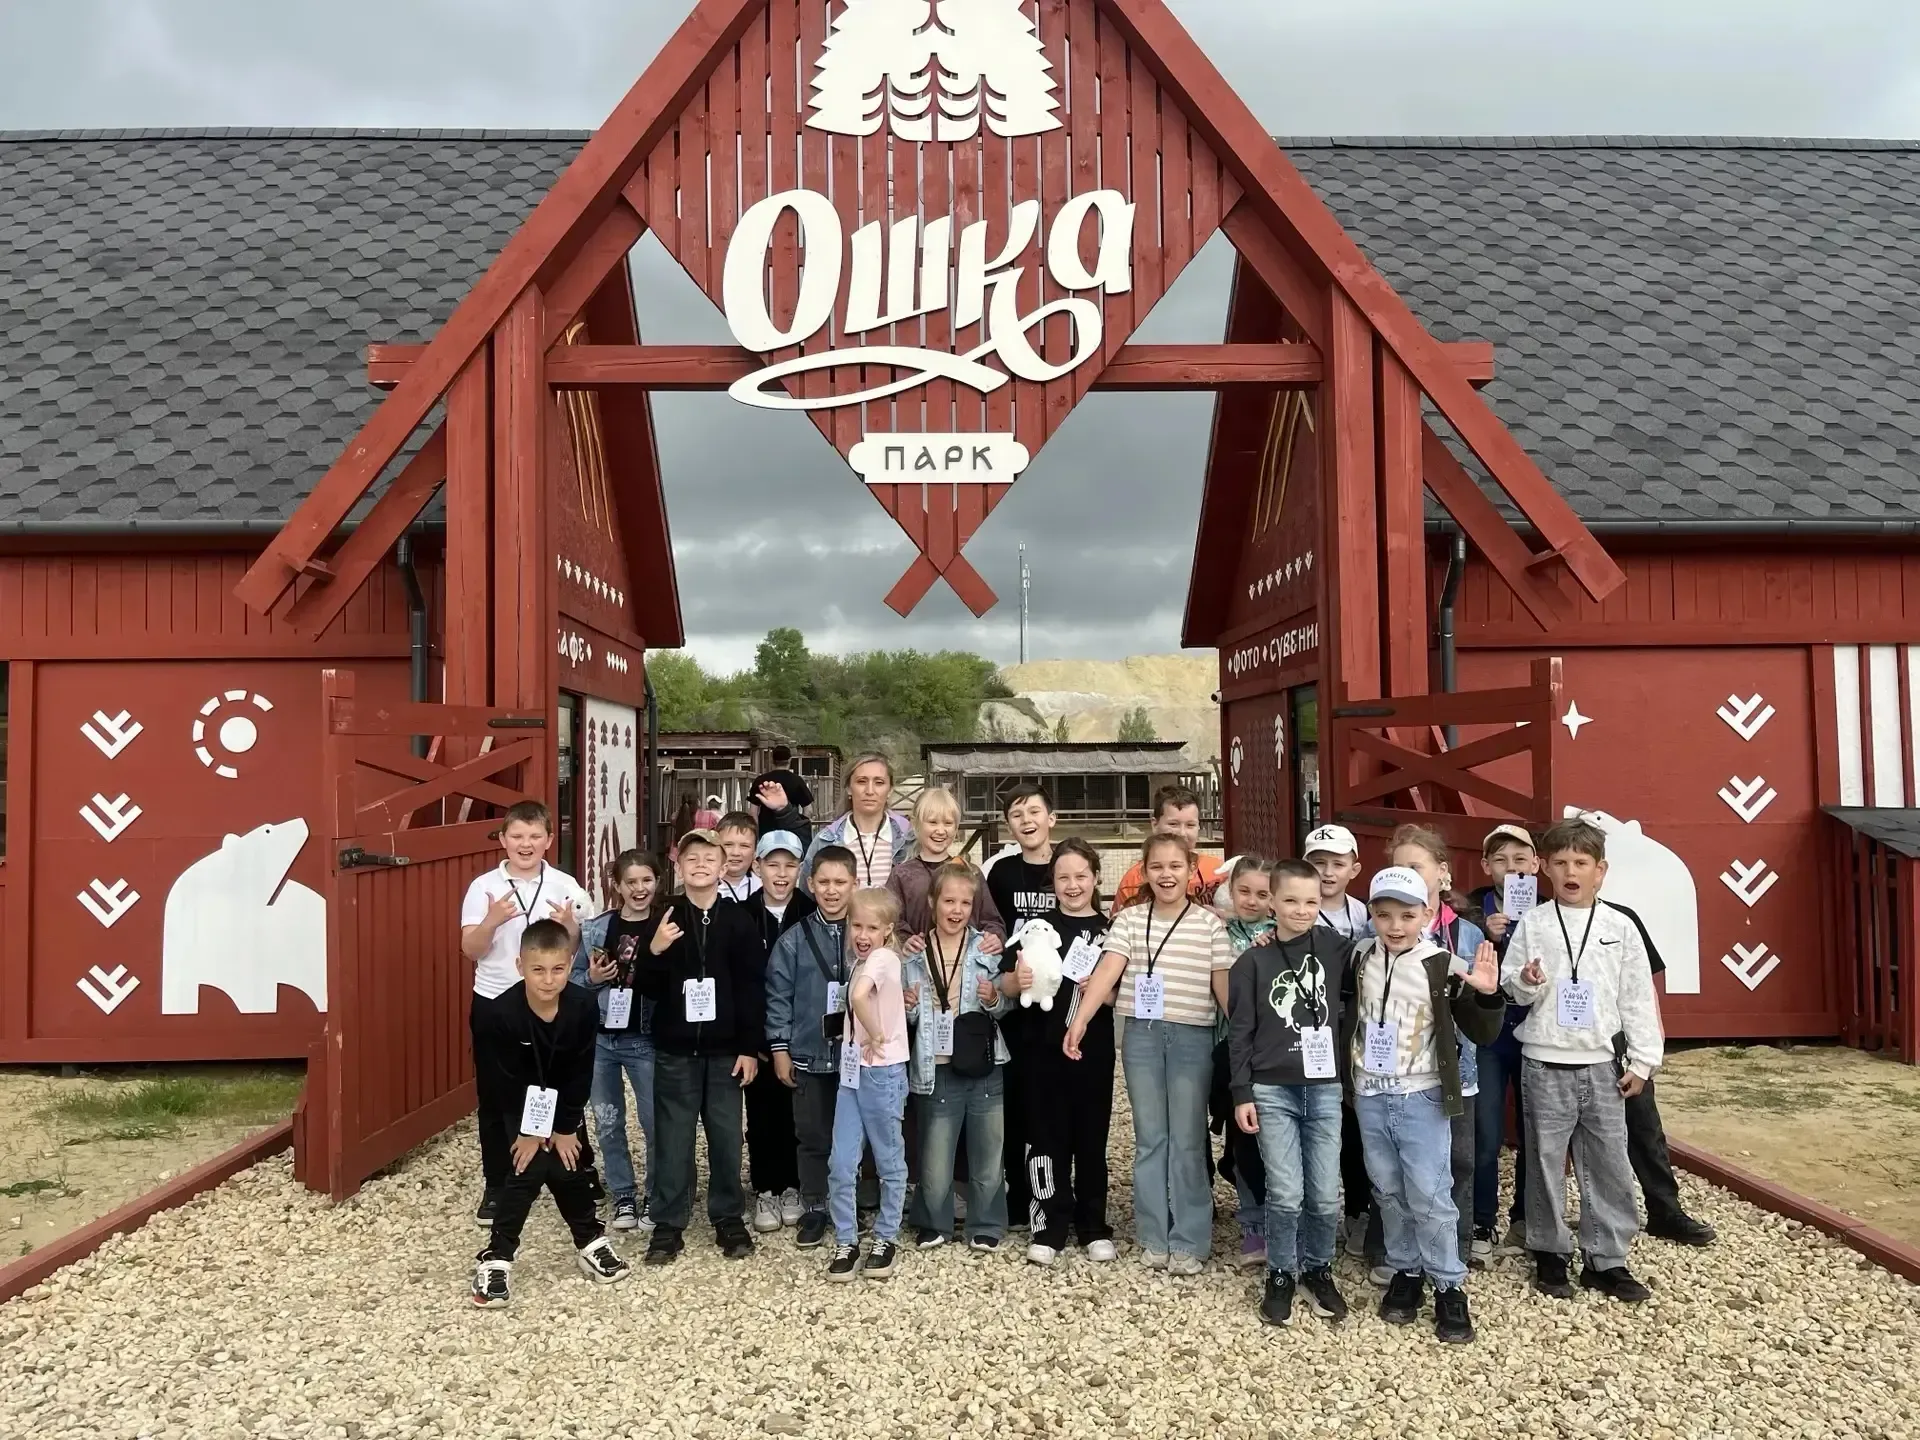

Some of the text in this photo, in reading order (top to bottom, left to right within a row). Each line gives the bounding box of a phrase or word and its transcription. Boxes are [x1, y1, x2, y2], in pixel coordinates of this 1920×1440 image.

[723, 189, 1136, 410] Ошка
[884, 445, 993, 471] ПАРК
[1233, 646, 1260, 679] ФОТО
[1364, 1077, 1401, 1091] SMILE
